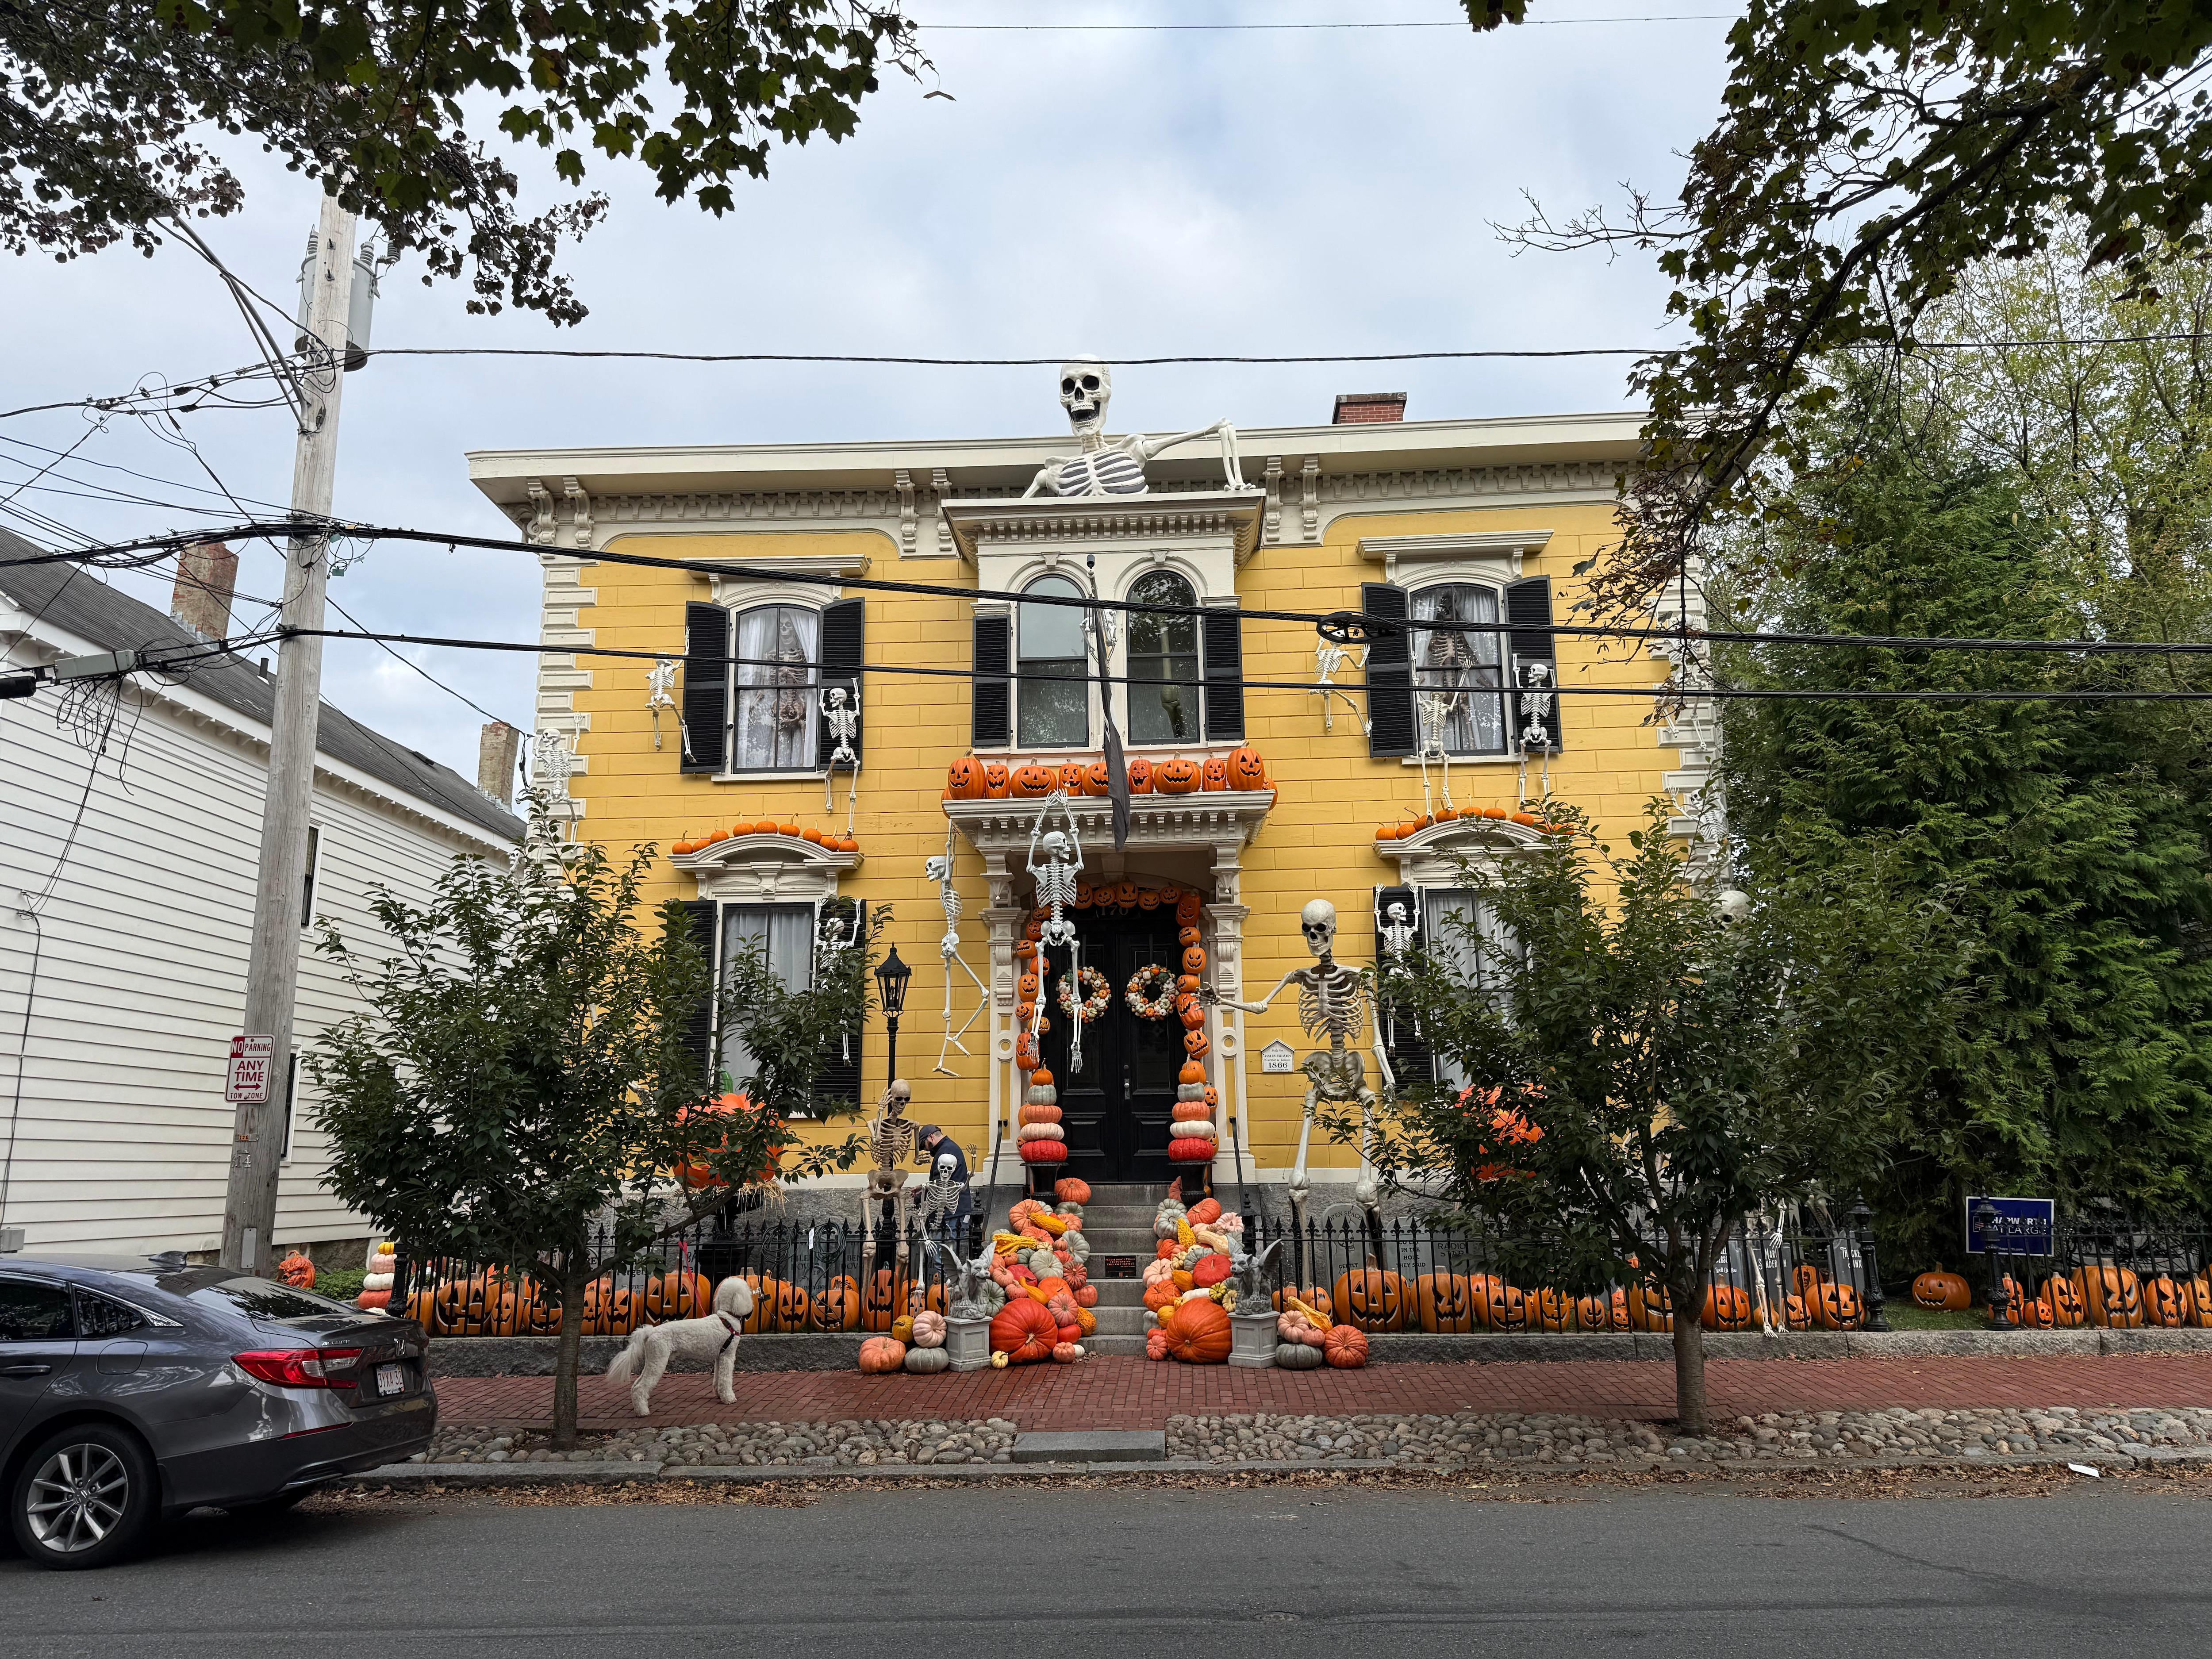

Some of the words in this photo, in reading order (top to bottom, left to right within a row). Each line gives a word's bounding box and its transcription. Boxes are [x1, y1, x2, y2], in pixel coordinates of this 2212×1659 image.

[1101, 905, 1129, 916] 170
[231, 1041, 243, 1053] NO
[244, 1043, 271, 1052] PARKING
[237, 1060, 265, 1071] ANY
[234, 1071, 264, 1082] TIME
[378, 1372, 394, 1388] 3YXA
[395, 1371, 403, 1385] 32
